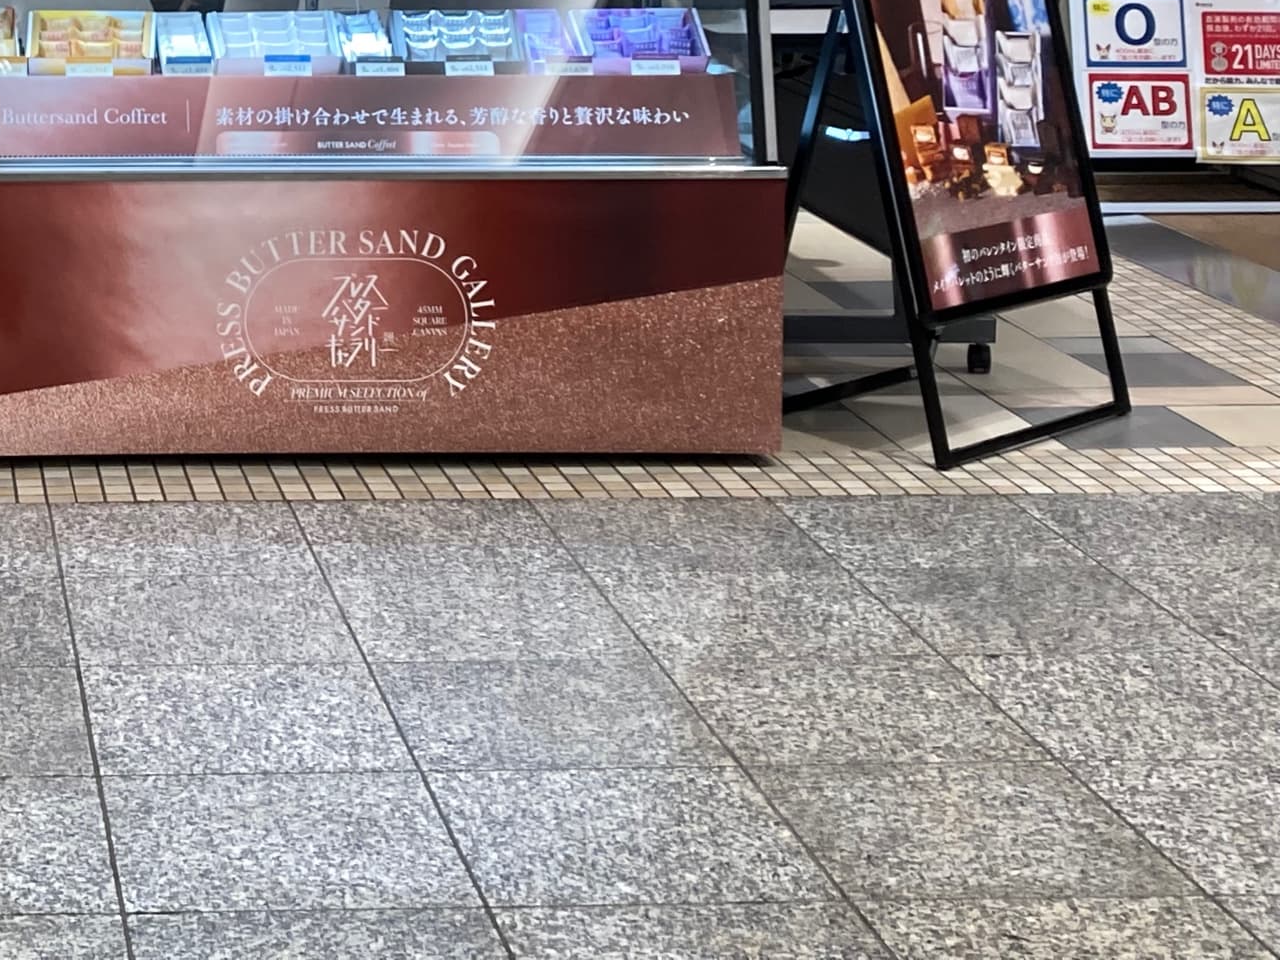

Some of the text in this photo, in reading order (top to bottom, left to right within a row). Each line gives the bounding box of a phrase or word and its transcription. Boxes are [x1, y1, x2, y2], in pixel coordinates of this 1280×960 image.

[1114, 2, 1157, 47] O
[1231, 43, 1254, 70] 21
[1121, 85, 1178, 116] AB
[2, 107, 168, 126] Buttersand Coffret
[1229, 97, 1272, 142] A
[317, 140, 344, 149] BUTTER
[216, 229, 497, 398] PRESS BUTTER SAND GALLERY
[412, 317, 447, 325] SQUARE
[291, 387, 348, 399] PREMIUM
